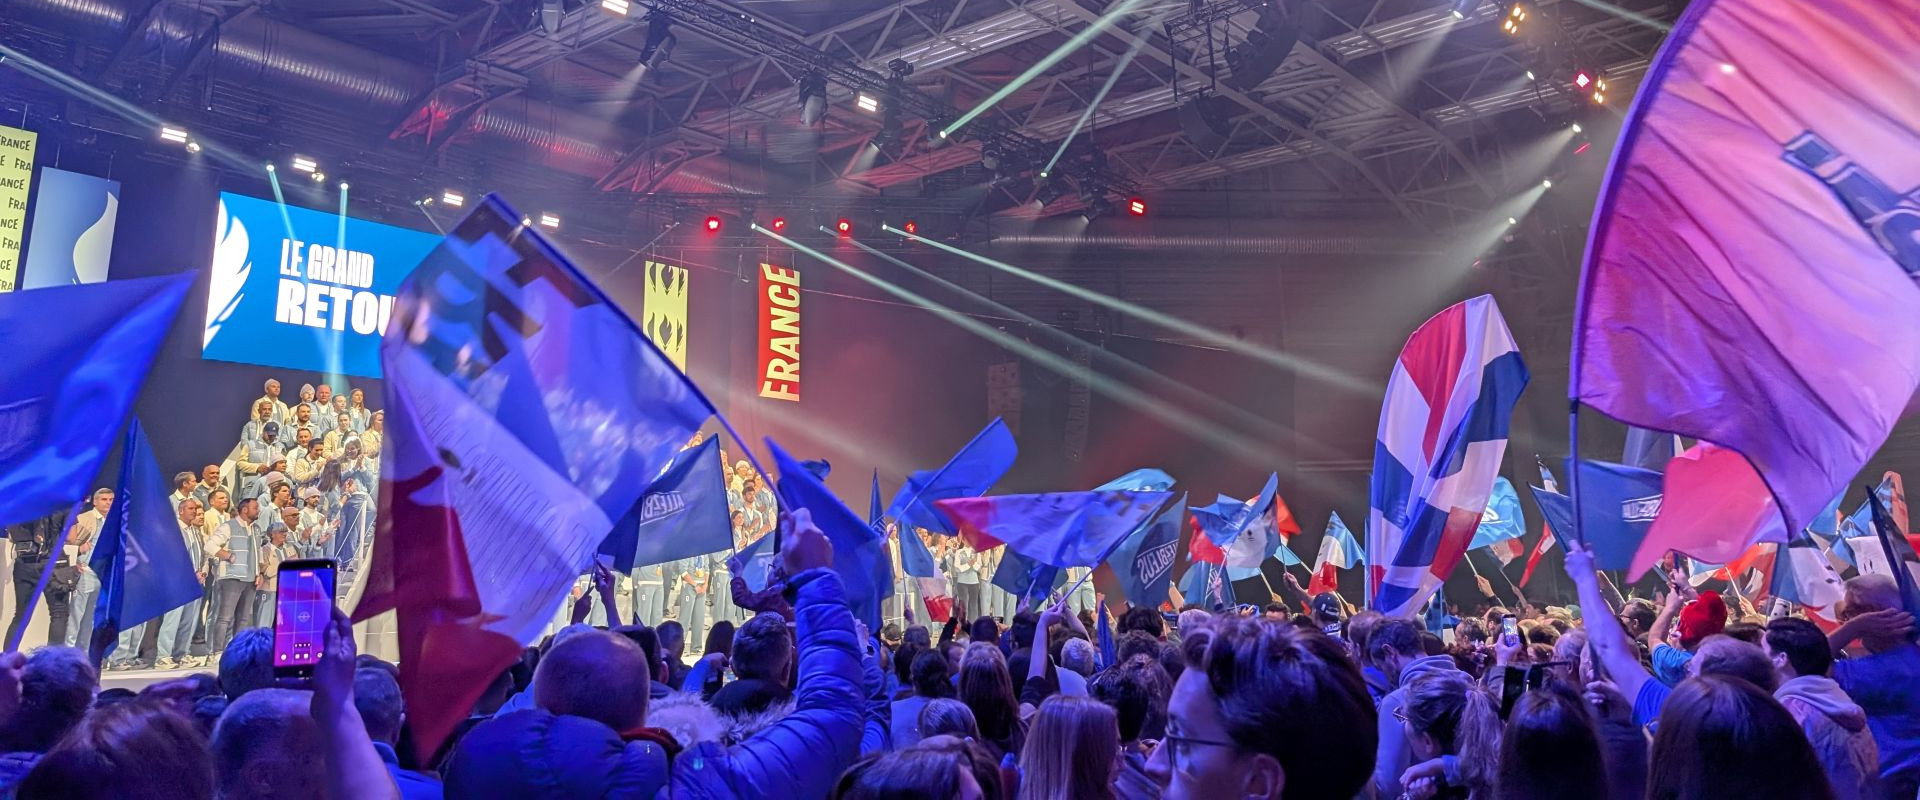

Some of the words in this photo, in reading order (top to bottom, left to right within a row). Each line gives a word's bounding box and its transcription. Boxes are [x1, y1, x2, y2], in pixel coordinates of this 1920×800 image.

[0, 134, 31, 151] RANCE
[280, 238, 305, 277] LE
[307, 243, 375, 289] GRAND
[760, 263, 801, 402] FRANCE
